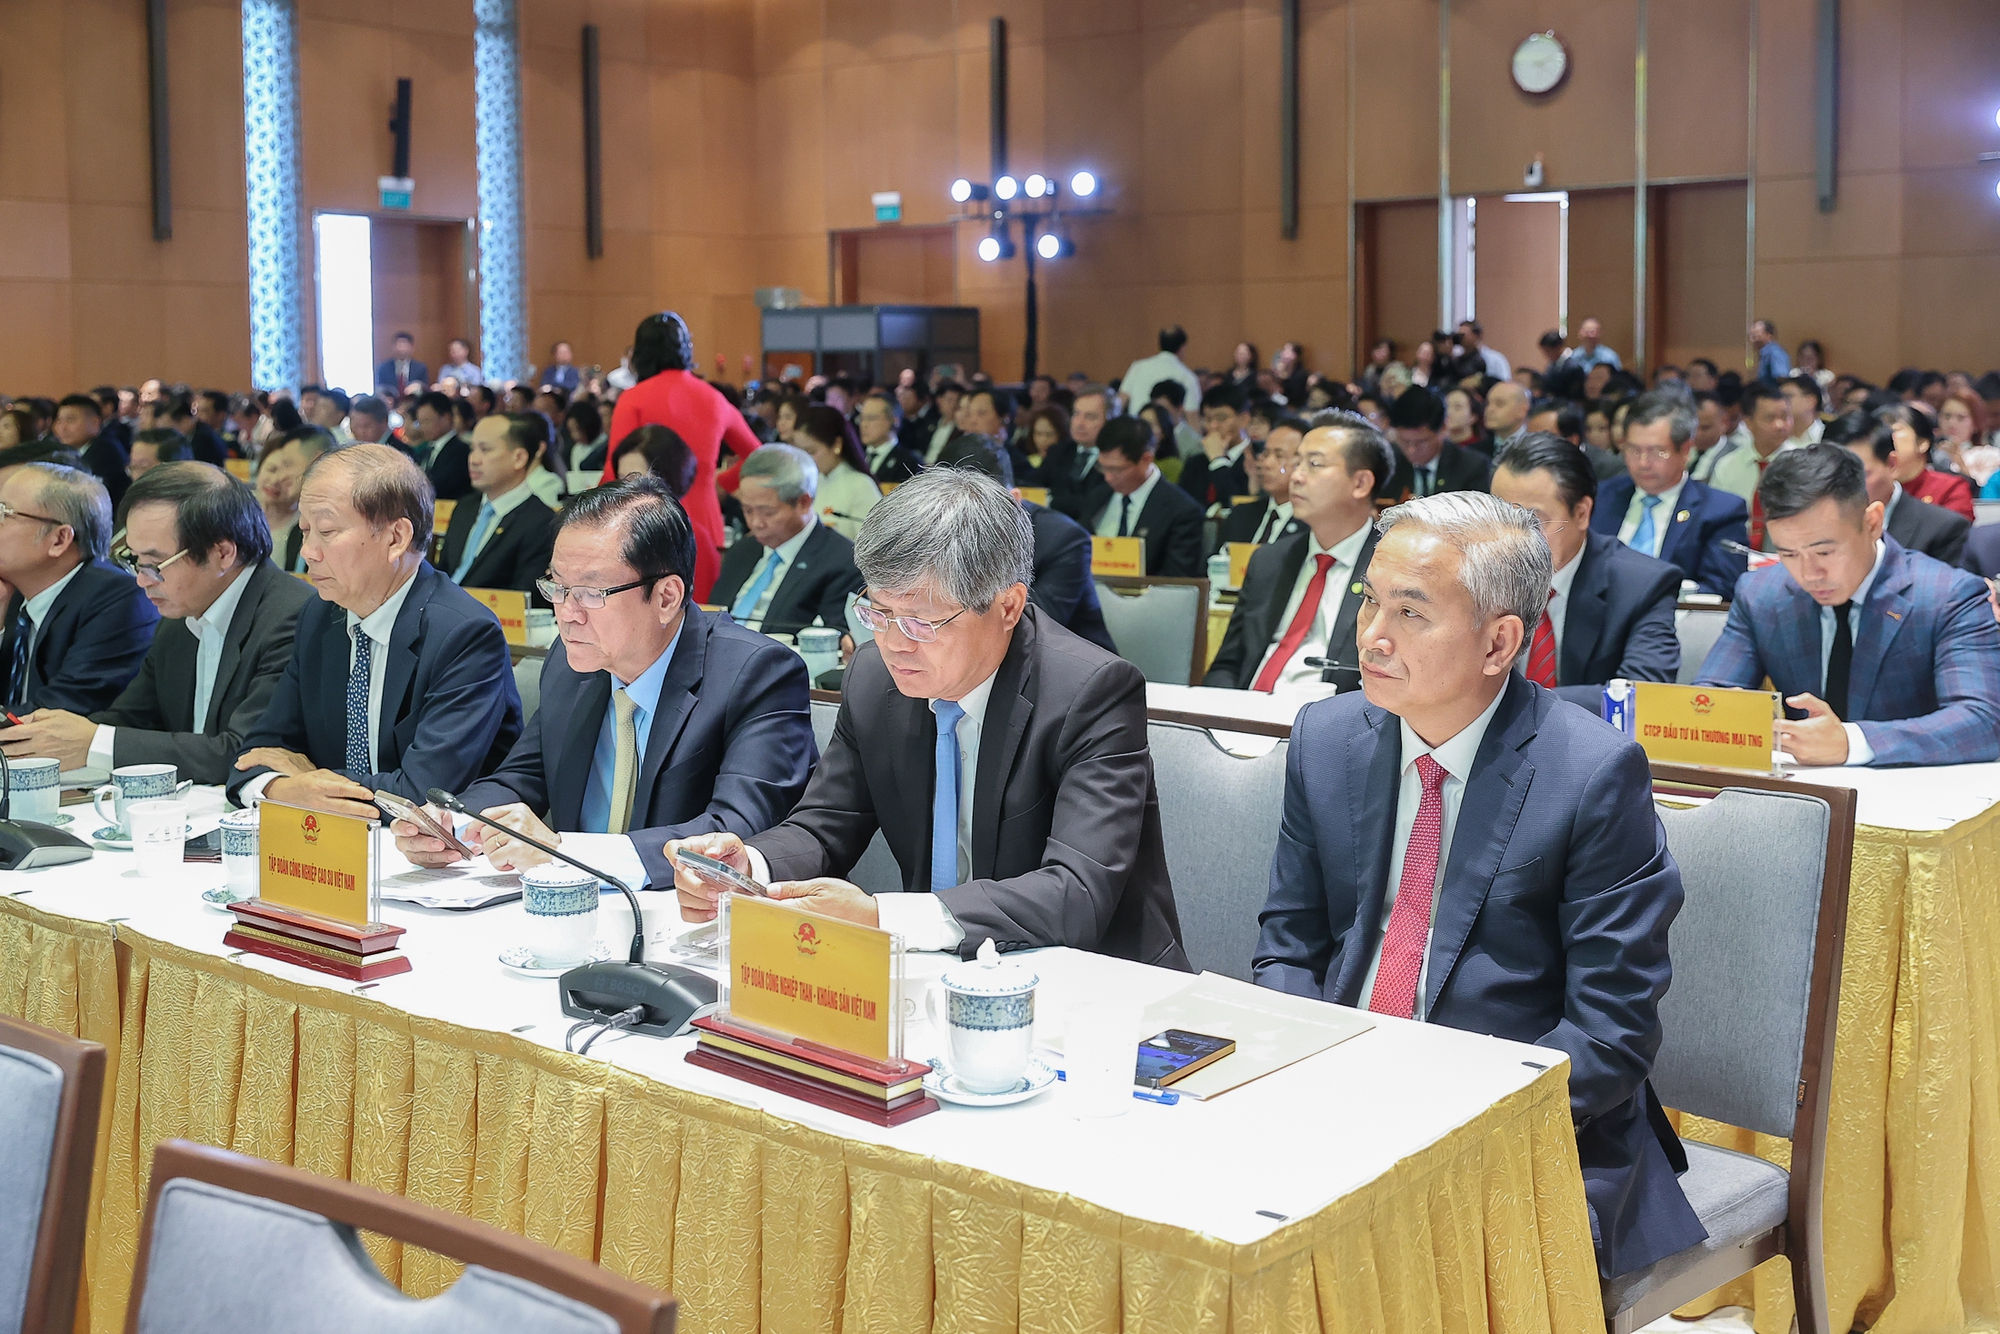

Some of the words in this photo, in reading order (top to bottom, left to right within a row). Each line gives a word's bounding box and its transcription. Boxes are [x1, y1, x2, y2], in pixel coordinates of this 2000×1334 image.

[1644, 724, 1661, 737] CTCP
[1690, 726, 1699, 742] VÀ
[1701, 730, 1729, 744] THƯƠNG
[1731, 732, 1746, 748] MẠI
[1748, 734, 1762, 747] TNG
[268, 853, 276, 875] TẬP
[277, 855, 289, 876] ĐOÀN
[289, 858, 301, 878] CÔNG
[301, 862, 317, 885] NGHIỆP
[317, 867, 327, 885] CAO
[327, 869, 334, 886] SU
[334, 868, 344, 891] VIỆT
[344, 874, 355, 891] NAM
[741, 962, 751, 988] TẬP
[751, 965, 765, 989] ĐOÀN
[765, 968, 779, 993] CÔNG
[780, 975, 799, 1002] NGHIỆP
[799, 981, 813, 1003] THAN
[838, 987, 850, 1014] SẢN
[850, 993, 863, 1021] VIỆT
[863, 1000, 876, 1021] NAM
